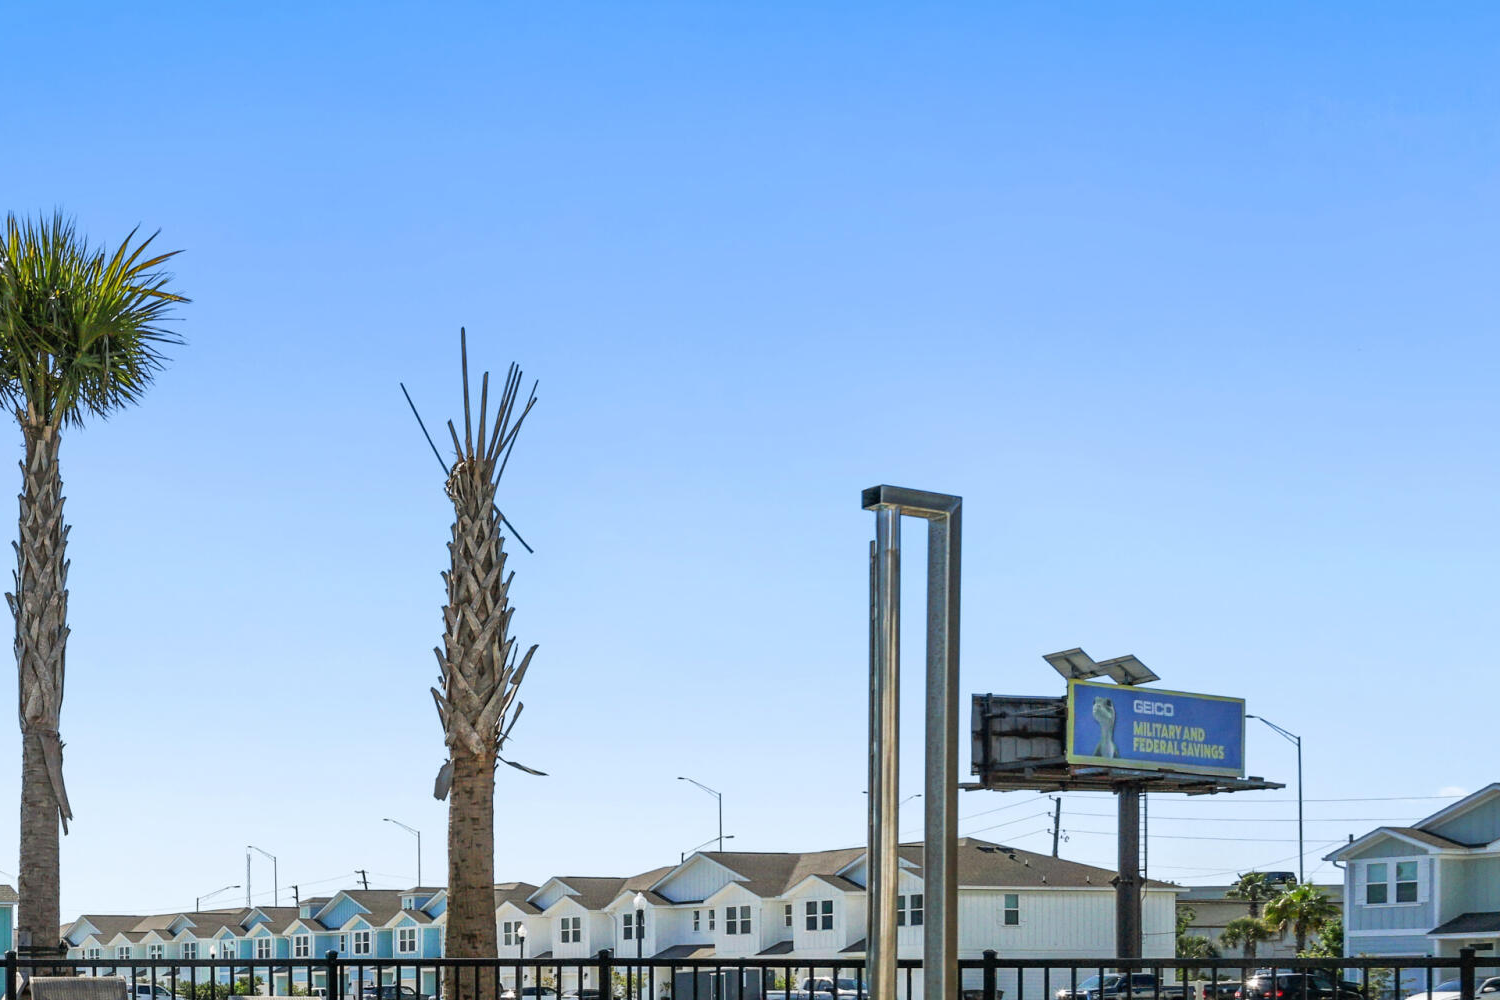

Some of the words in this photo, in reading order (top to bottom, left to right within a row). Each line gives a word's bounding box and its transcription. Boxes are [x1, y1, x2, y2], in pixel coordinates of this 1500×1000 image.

[1133, 700, 1174, 717] GEICO
[1133, 721, 1182, 740] MILITARY
[1183, 726, 1205, 742] AND
[1133, 737, 1180, 756] FEDERAL
[1181, 742, 1225, 759] SAVINGS
